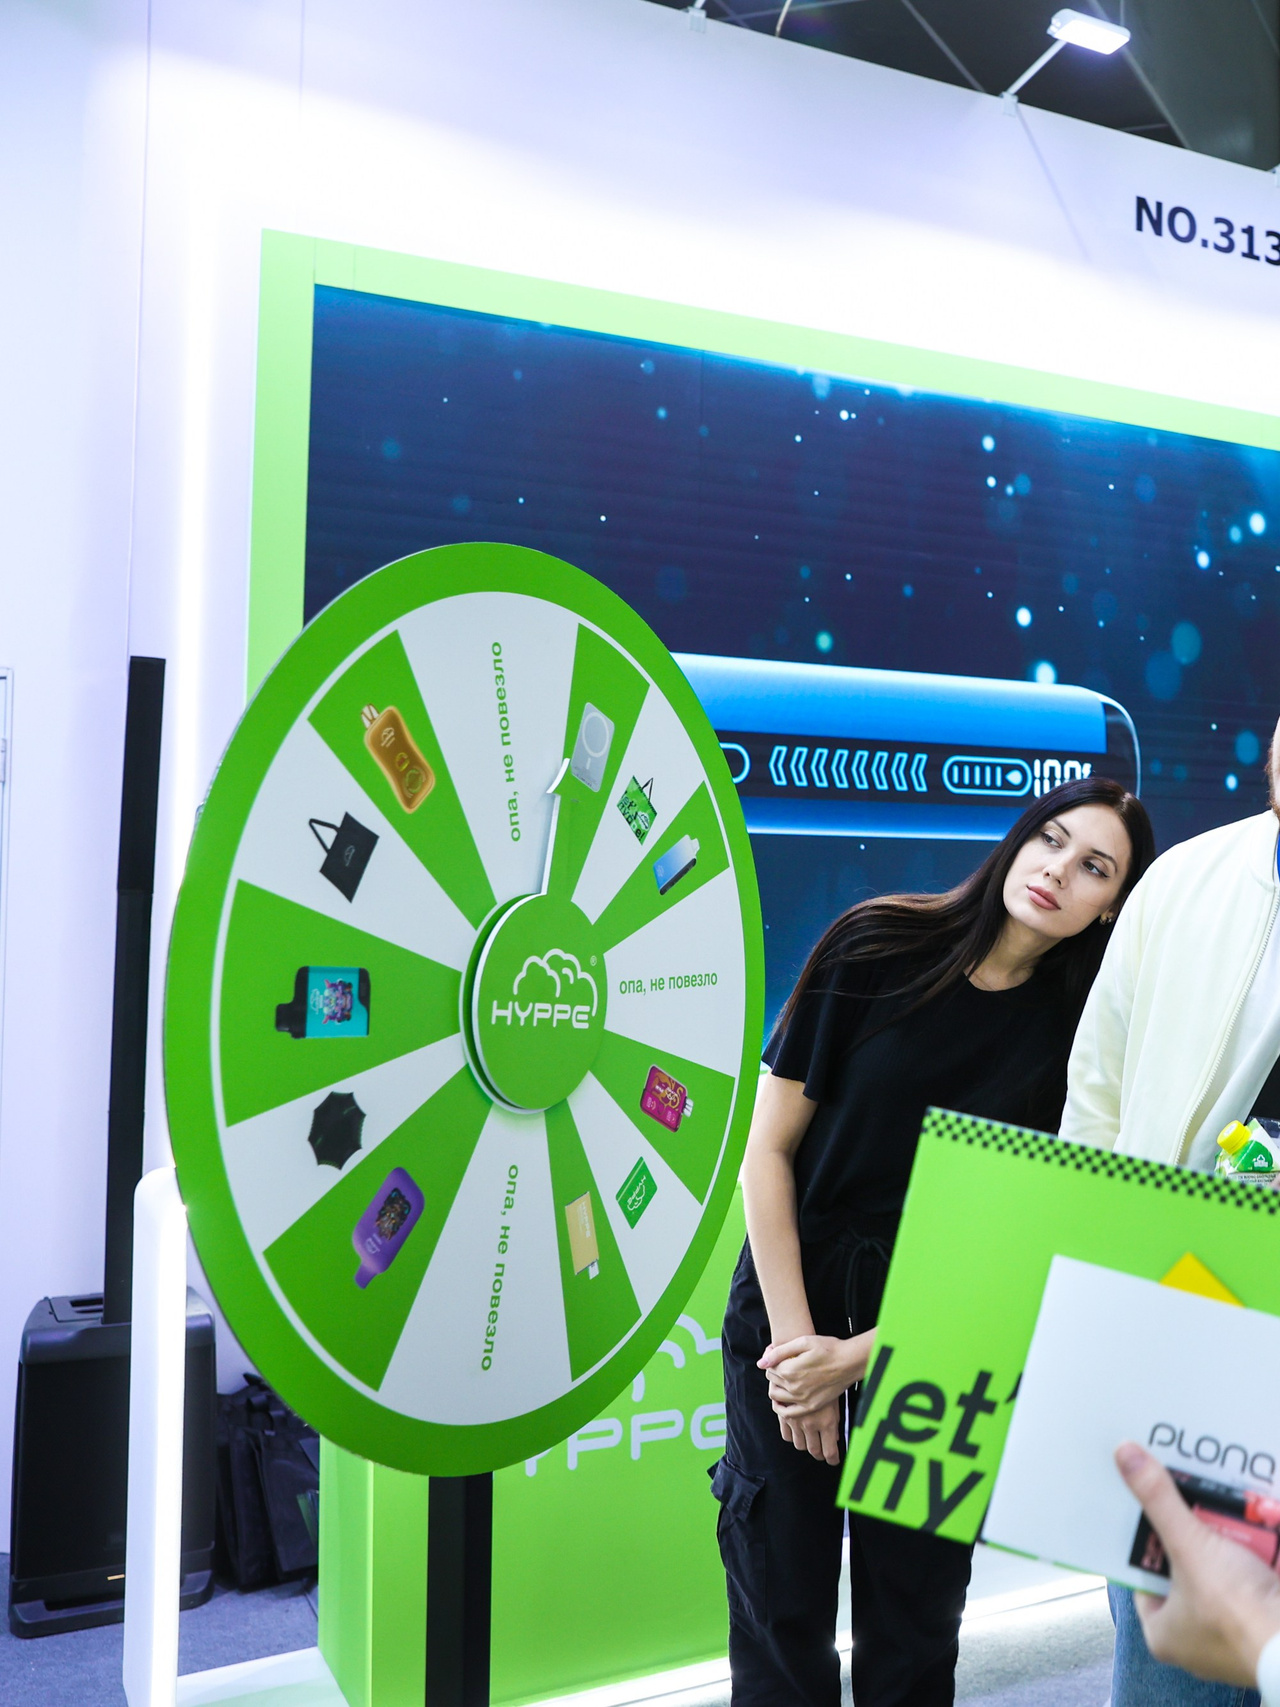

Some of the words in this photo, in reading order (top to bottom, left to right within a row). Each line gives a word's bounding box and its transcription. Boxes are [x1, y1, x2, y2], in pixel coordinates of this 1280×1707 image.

[491, 642, 512, 746] повезло
[503, 754, 515, 782] не
[508, 791, 521, 842] опа,
[619, 978, 646, 996] опа,
[650, 976, 665, 991] не
[668, 972, 718, 990] повезло
[491, 999, 591, 1029] HYPPE
[501, 1164, 519, 1216] опа,
[497, 1225, 511, 1255] не
[481, 1263, 506, 1371] повезло
[855, 1345, 1023, 1459] let'
[525, 1401, 727, 1477] PPE
[849, 1418, 986, 1535] hy
